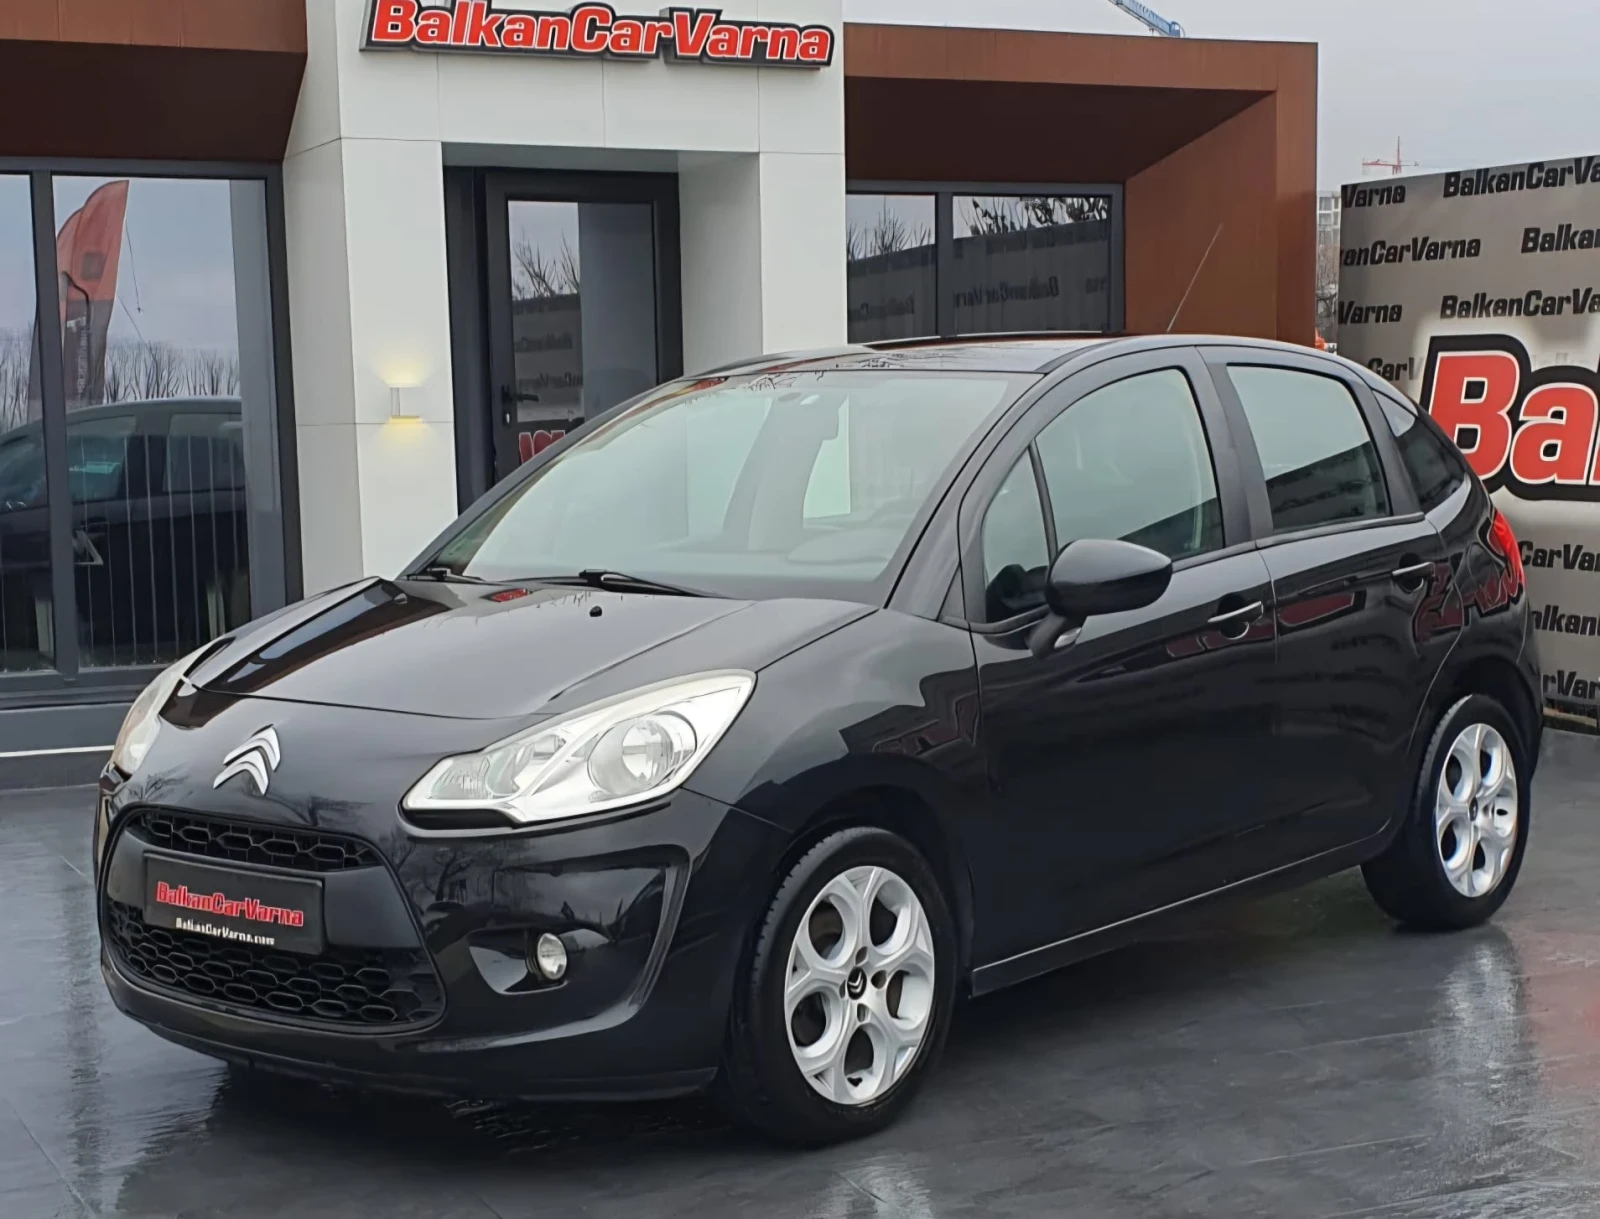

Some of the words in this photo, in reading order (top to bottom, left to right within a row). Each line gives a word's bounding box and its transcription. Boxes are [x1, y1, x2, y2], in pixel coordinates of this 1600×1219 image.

[369, 0, 831, 62] BalkanCarVarna
[1341, 184, 1406, 208] Varna
[1338, 300, 1403, 325] Varna
[156, 881, 304, 927] BalkanCarVarna
